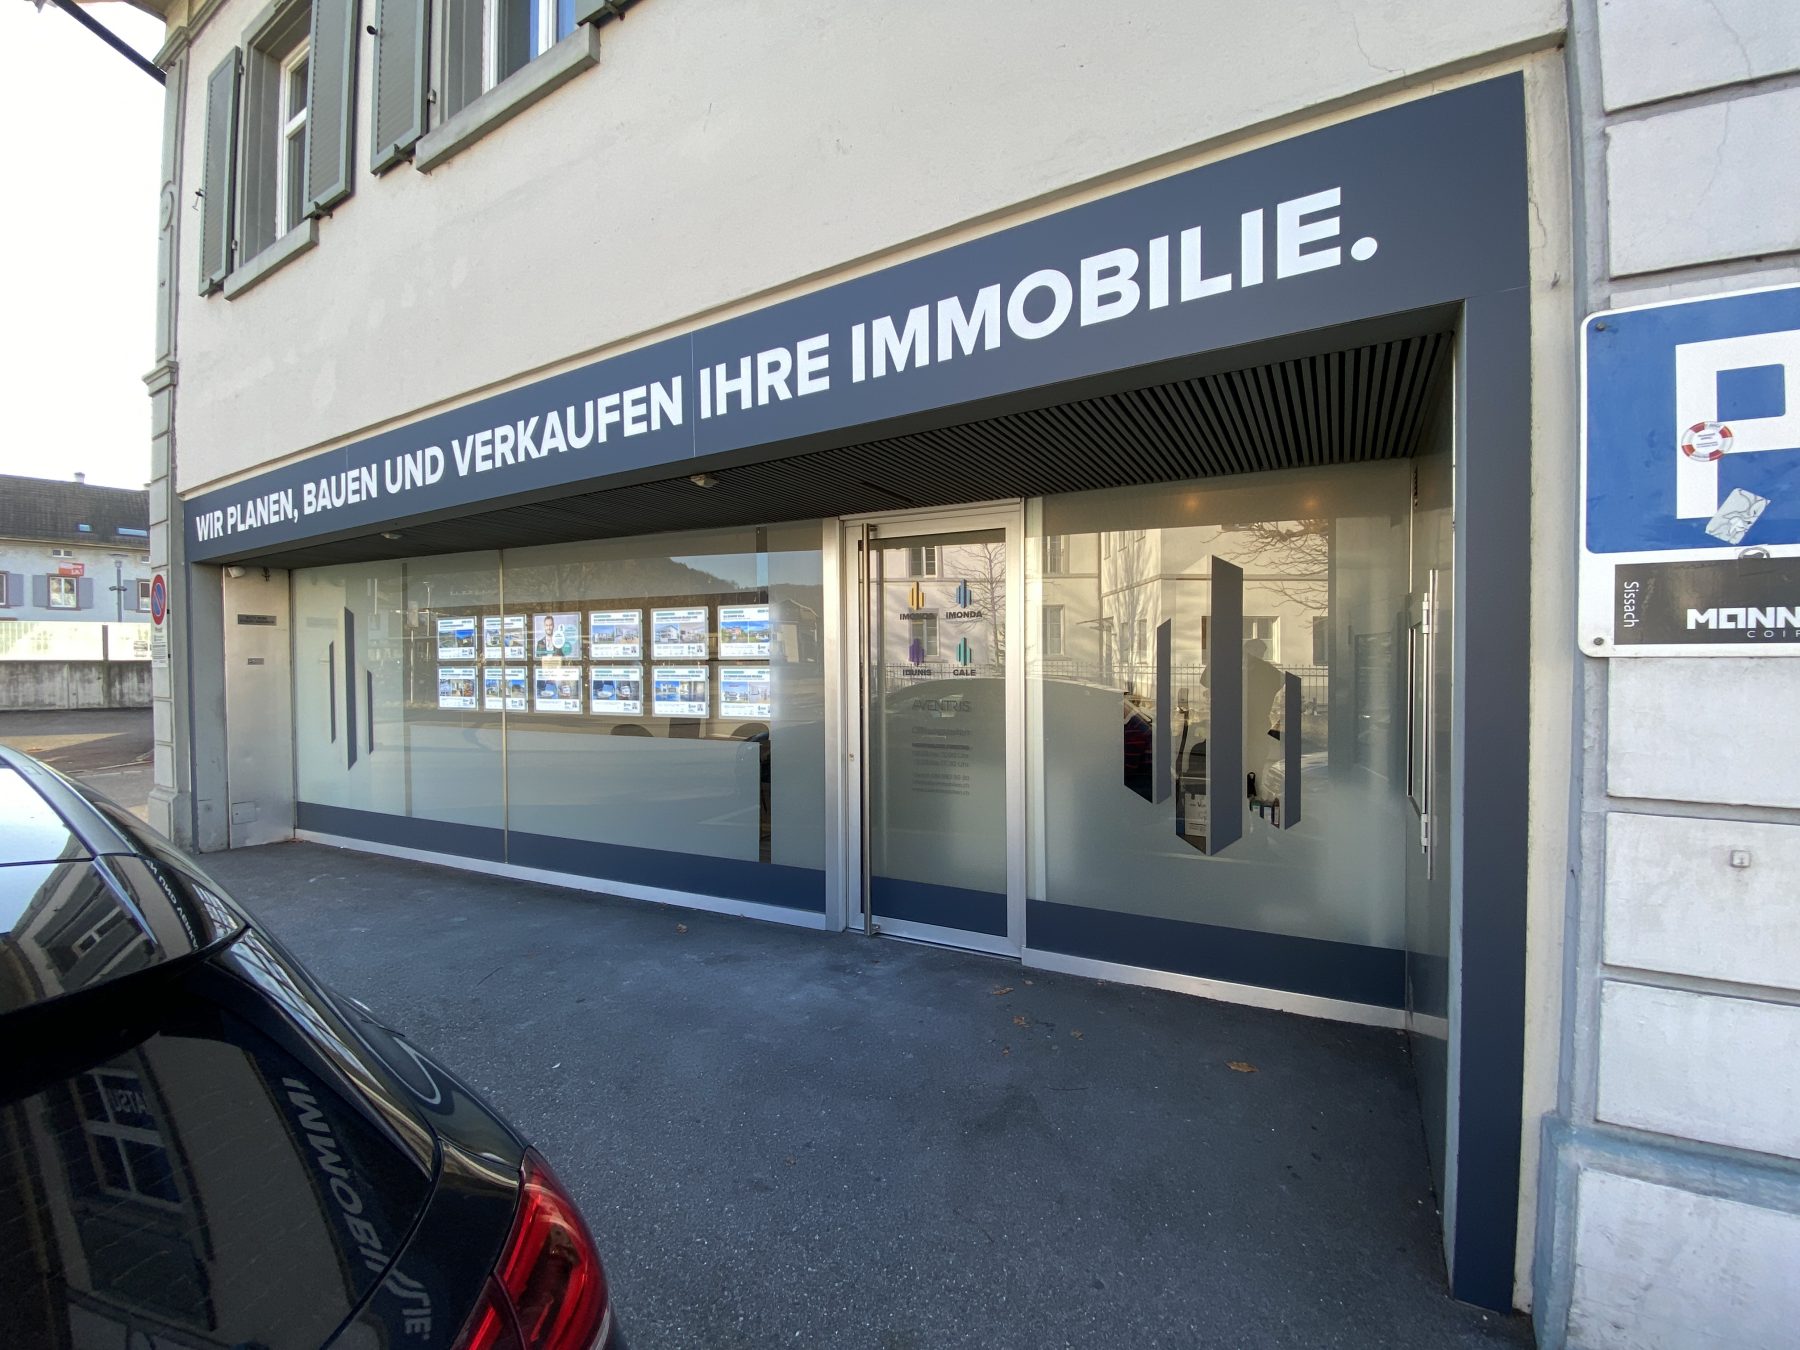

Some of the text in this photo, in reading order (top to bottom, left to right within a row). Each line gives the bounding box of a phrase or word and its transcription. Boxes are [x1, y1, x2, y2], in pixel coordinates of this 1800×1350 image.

[196, 187, 1378, 542] WIR PLANEN, BAUEN UND VERKAUFEN IHRE IMMOBILIE.
[1675, 329, 1800, 519] P
[945, 610, 983, 619] IMONDA
[1623, 581, 1640, 628] Sissach
[952, 669, 977, 677] CALE
